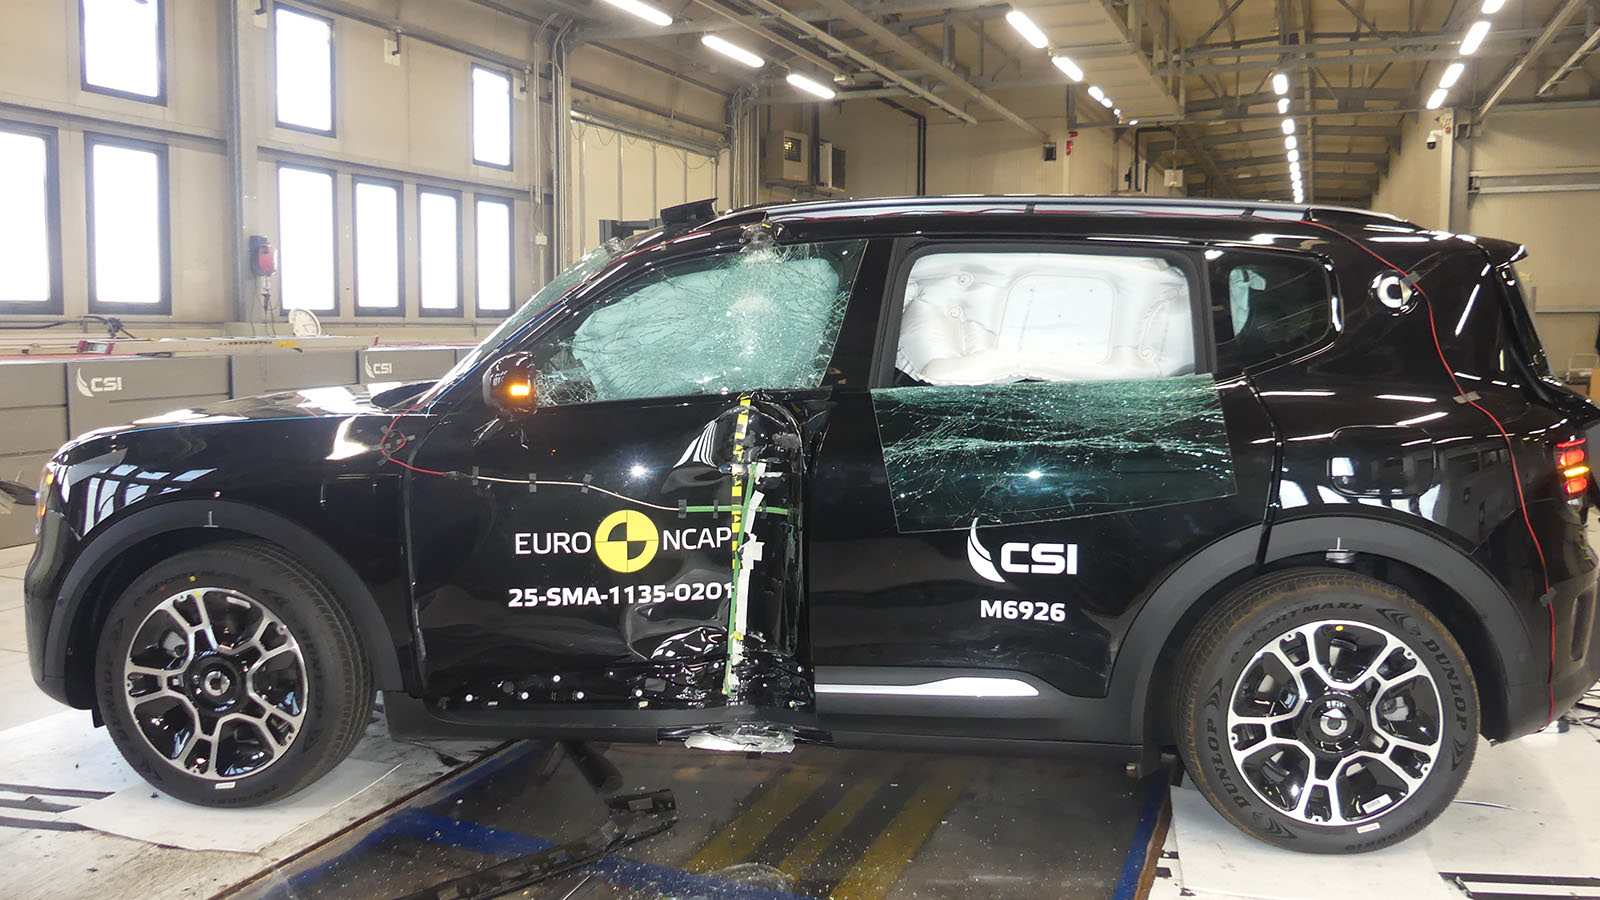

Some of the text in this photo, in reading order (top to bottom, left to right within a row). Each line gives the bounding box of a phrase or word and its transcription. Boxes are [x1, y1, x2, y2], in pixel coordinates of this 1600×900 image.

[373, 363, 392, 374] CSI
[91, 377, 122, 392] CSI
[515, 527, 732, 554] EURO NCAP
[1001, 542, 1078, 575] CSI
[508, 582, 735, 607] 25-SMA-1135-0201
[980, 599, 1066, 622] M6926
[1303, 602, 1363, 613] MAXX
[1422, 639, 1468, 731] DUNLOP
[1207, 718, 1251, 808] DUNLOP
